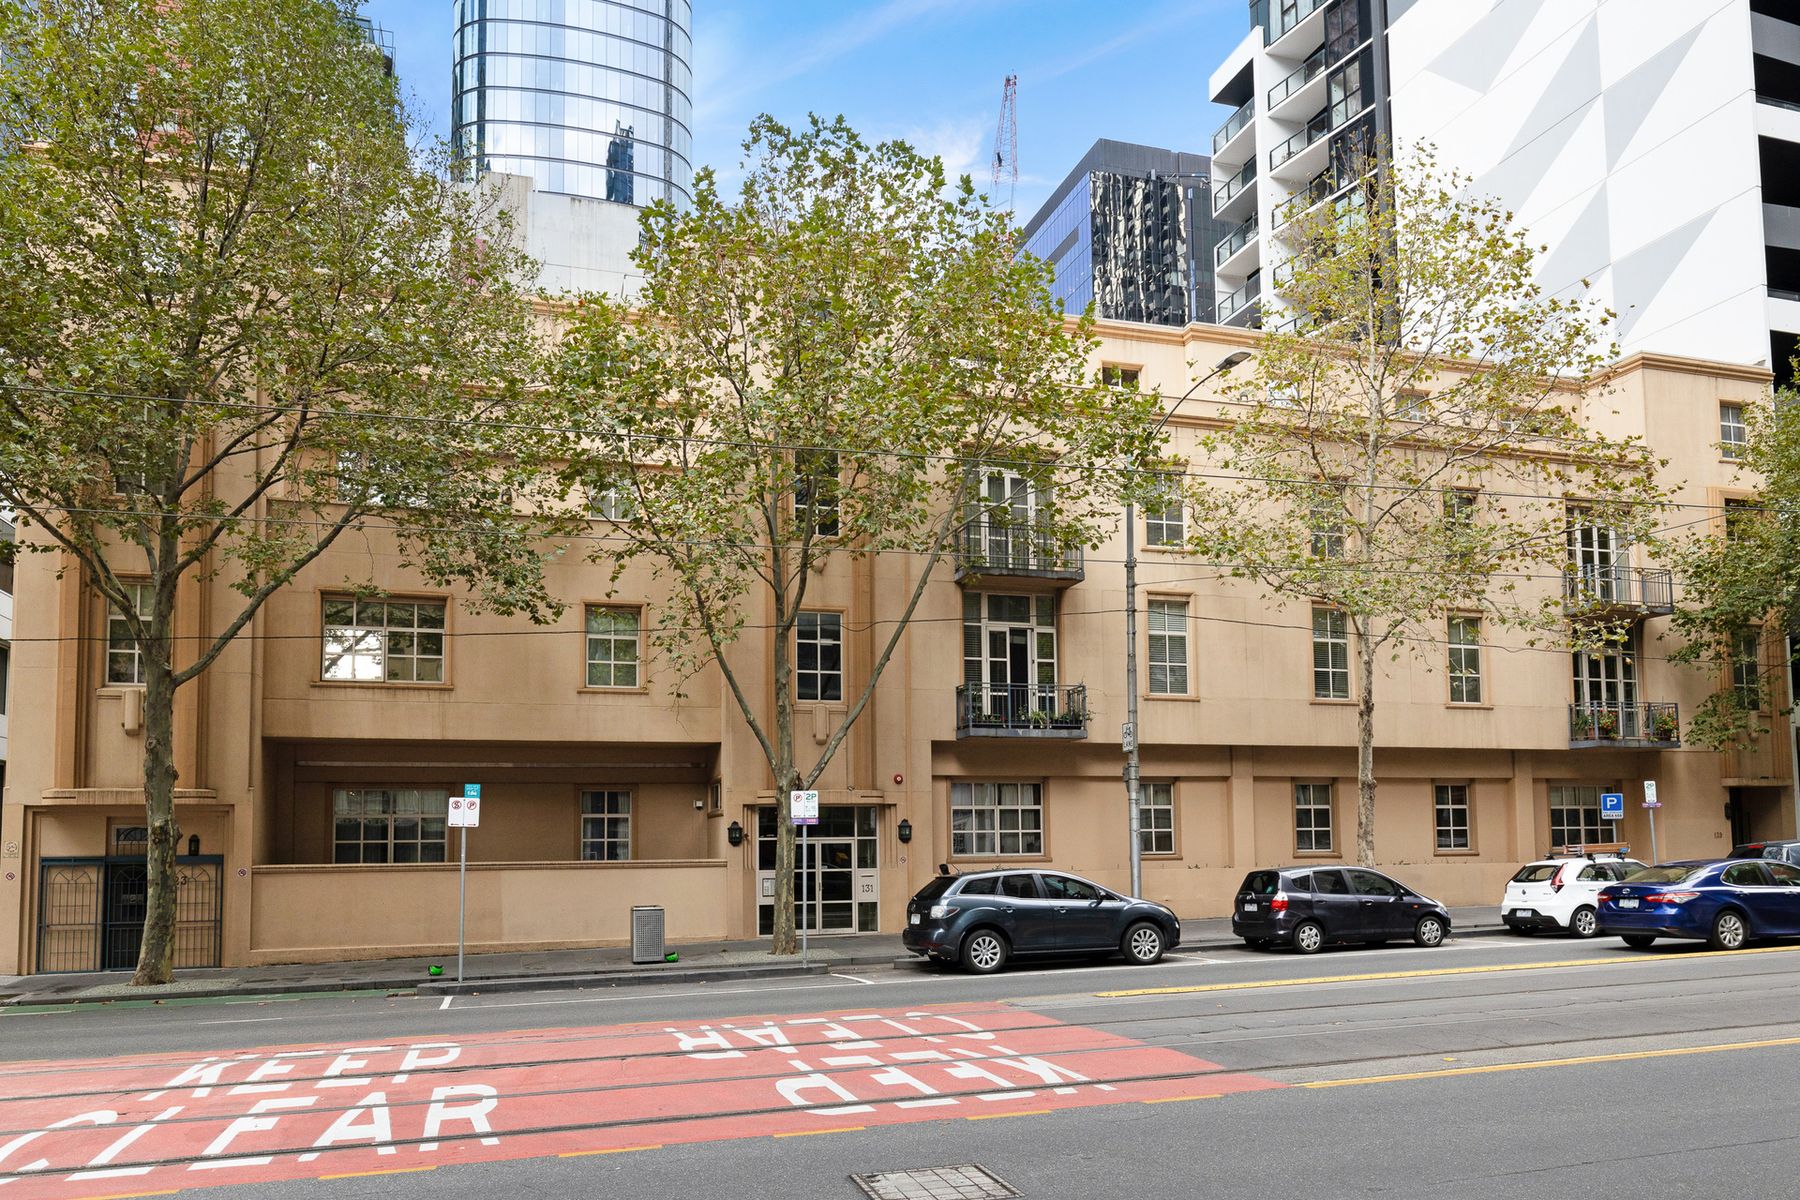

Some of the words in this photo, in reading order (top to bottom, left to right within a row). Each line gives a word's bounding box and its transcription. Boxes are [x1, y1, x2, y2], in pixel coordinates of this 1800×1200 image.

[805, 793, 817, 801] 2P
[1606, 797, 1617, 809] P
[861, 884, 874, 893] 131
[663, 1011, 996, 1060] CLEAR
[138, 1042, 462, 1101] KEEP
[775, 1045, 1117, 1115] KEEP
[0, 1084, 500, 1185] CLEAR
